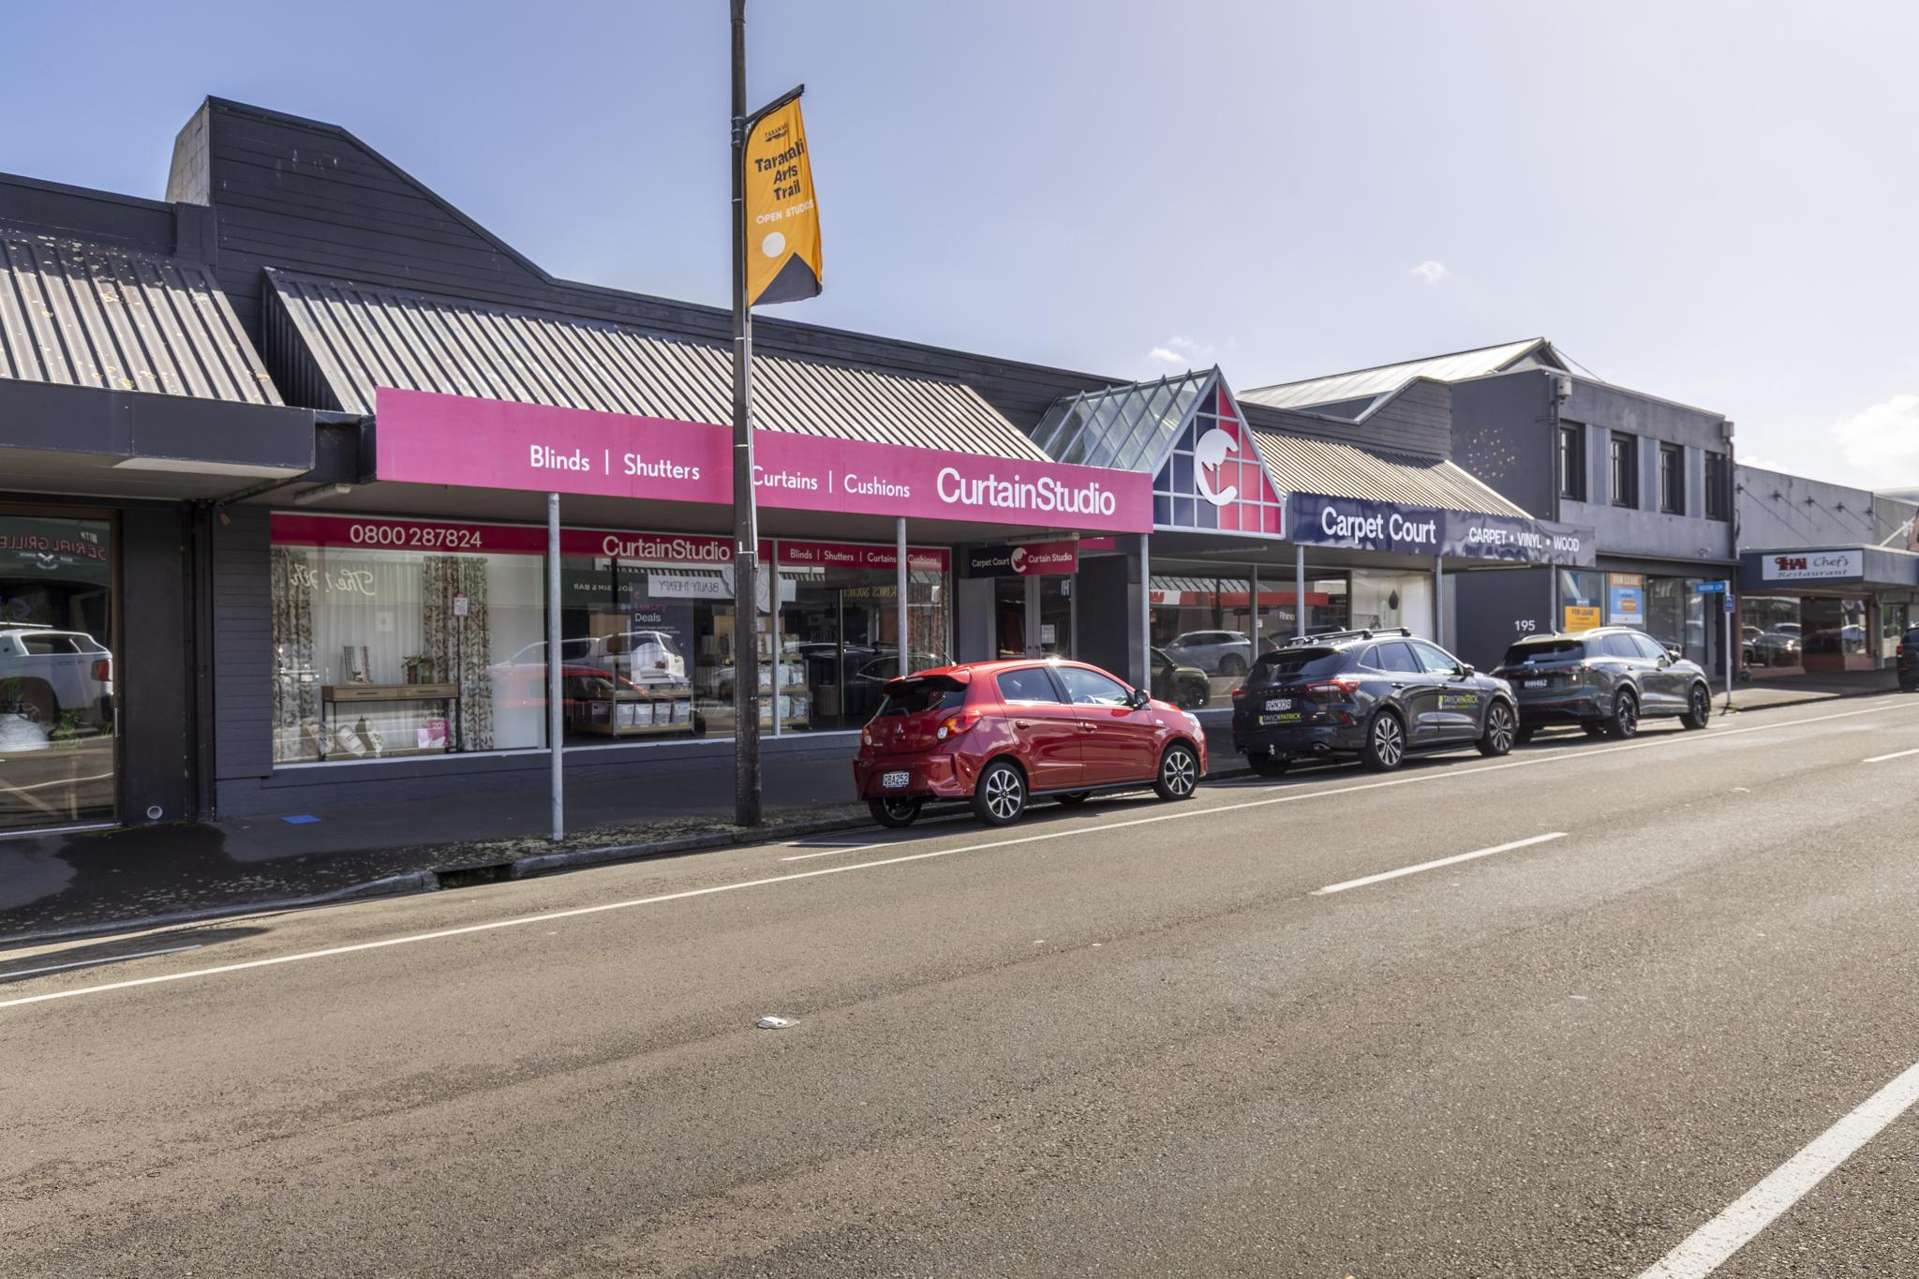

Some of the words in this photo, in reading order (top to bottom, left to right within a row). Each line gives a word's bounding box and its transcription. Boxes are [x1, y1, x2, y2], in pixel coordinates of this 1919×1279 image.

[774, 180, 801, 201] Trail
[756, 209, 783, 224] OPEN
[530, 444, 590, 471] Blinds
[624, 453, 700, 480] Shutters
[752, 465, 818, 491] Curtains
[844, 474, 910, 498] Cushions
[936, 467, 1116, 516] CurtainStudio
[350, 524, 405, 545] 0800
[409, 528, 482, 548] 287824
[1322, 506, 1384, 544] Carpet
[1389, 513, 1436, 543] Court
[602, 535, 730, 561] CurtainStudio
[1468, 527, 1506, 545] CARPET
[1517, 532, 1542, 549] VINYL
[1553, 535, 1580, 552] WOOD
[790, 548, 813, 560] Blinds
[824, 550, 854, 562] Shutters
[867, 552, 897, 563] Curtains
[971, 559, 992, 568] Carpet
[993, 557, 1010, 567] Court
[1028, 555, 1051, 564] Curtain
[1052, 552, 1073, 562] Studio
[1778, 569, 1848, 578] Restaurant
[634, 613, 662, 623] Deals
[1514, 620, 1536, 632] 195
